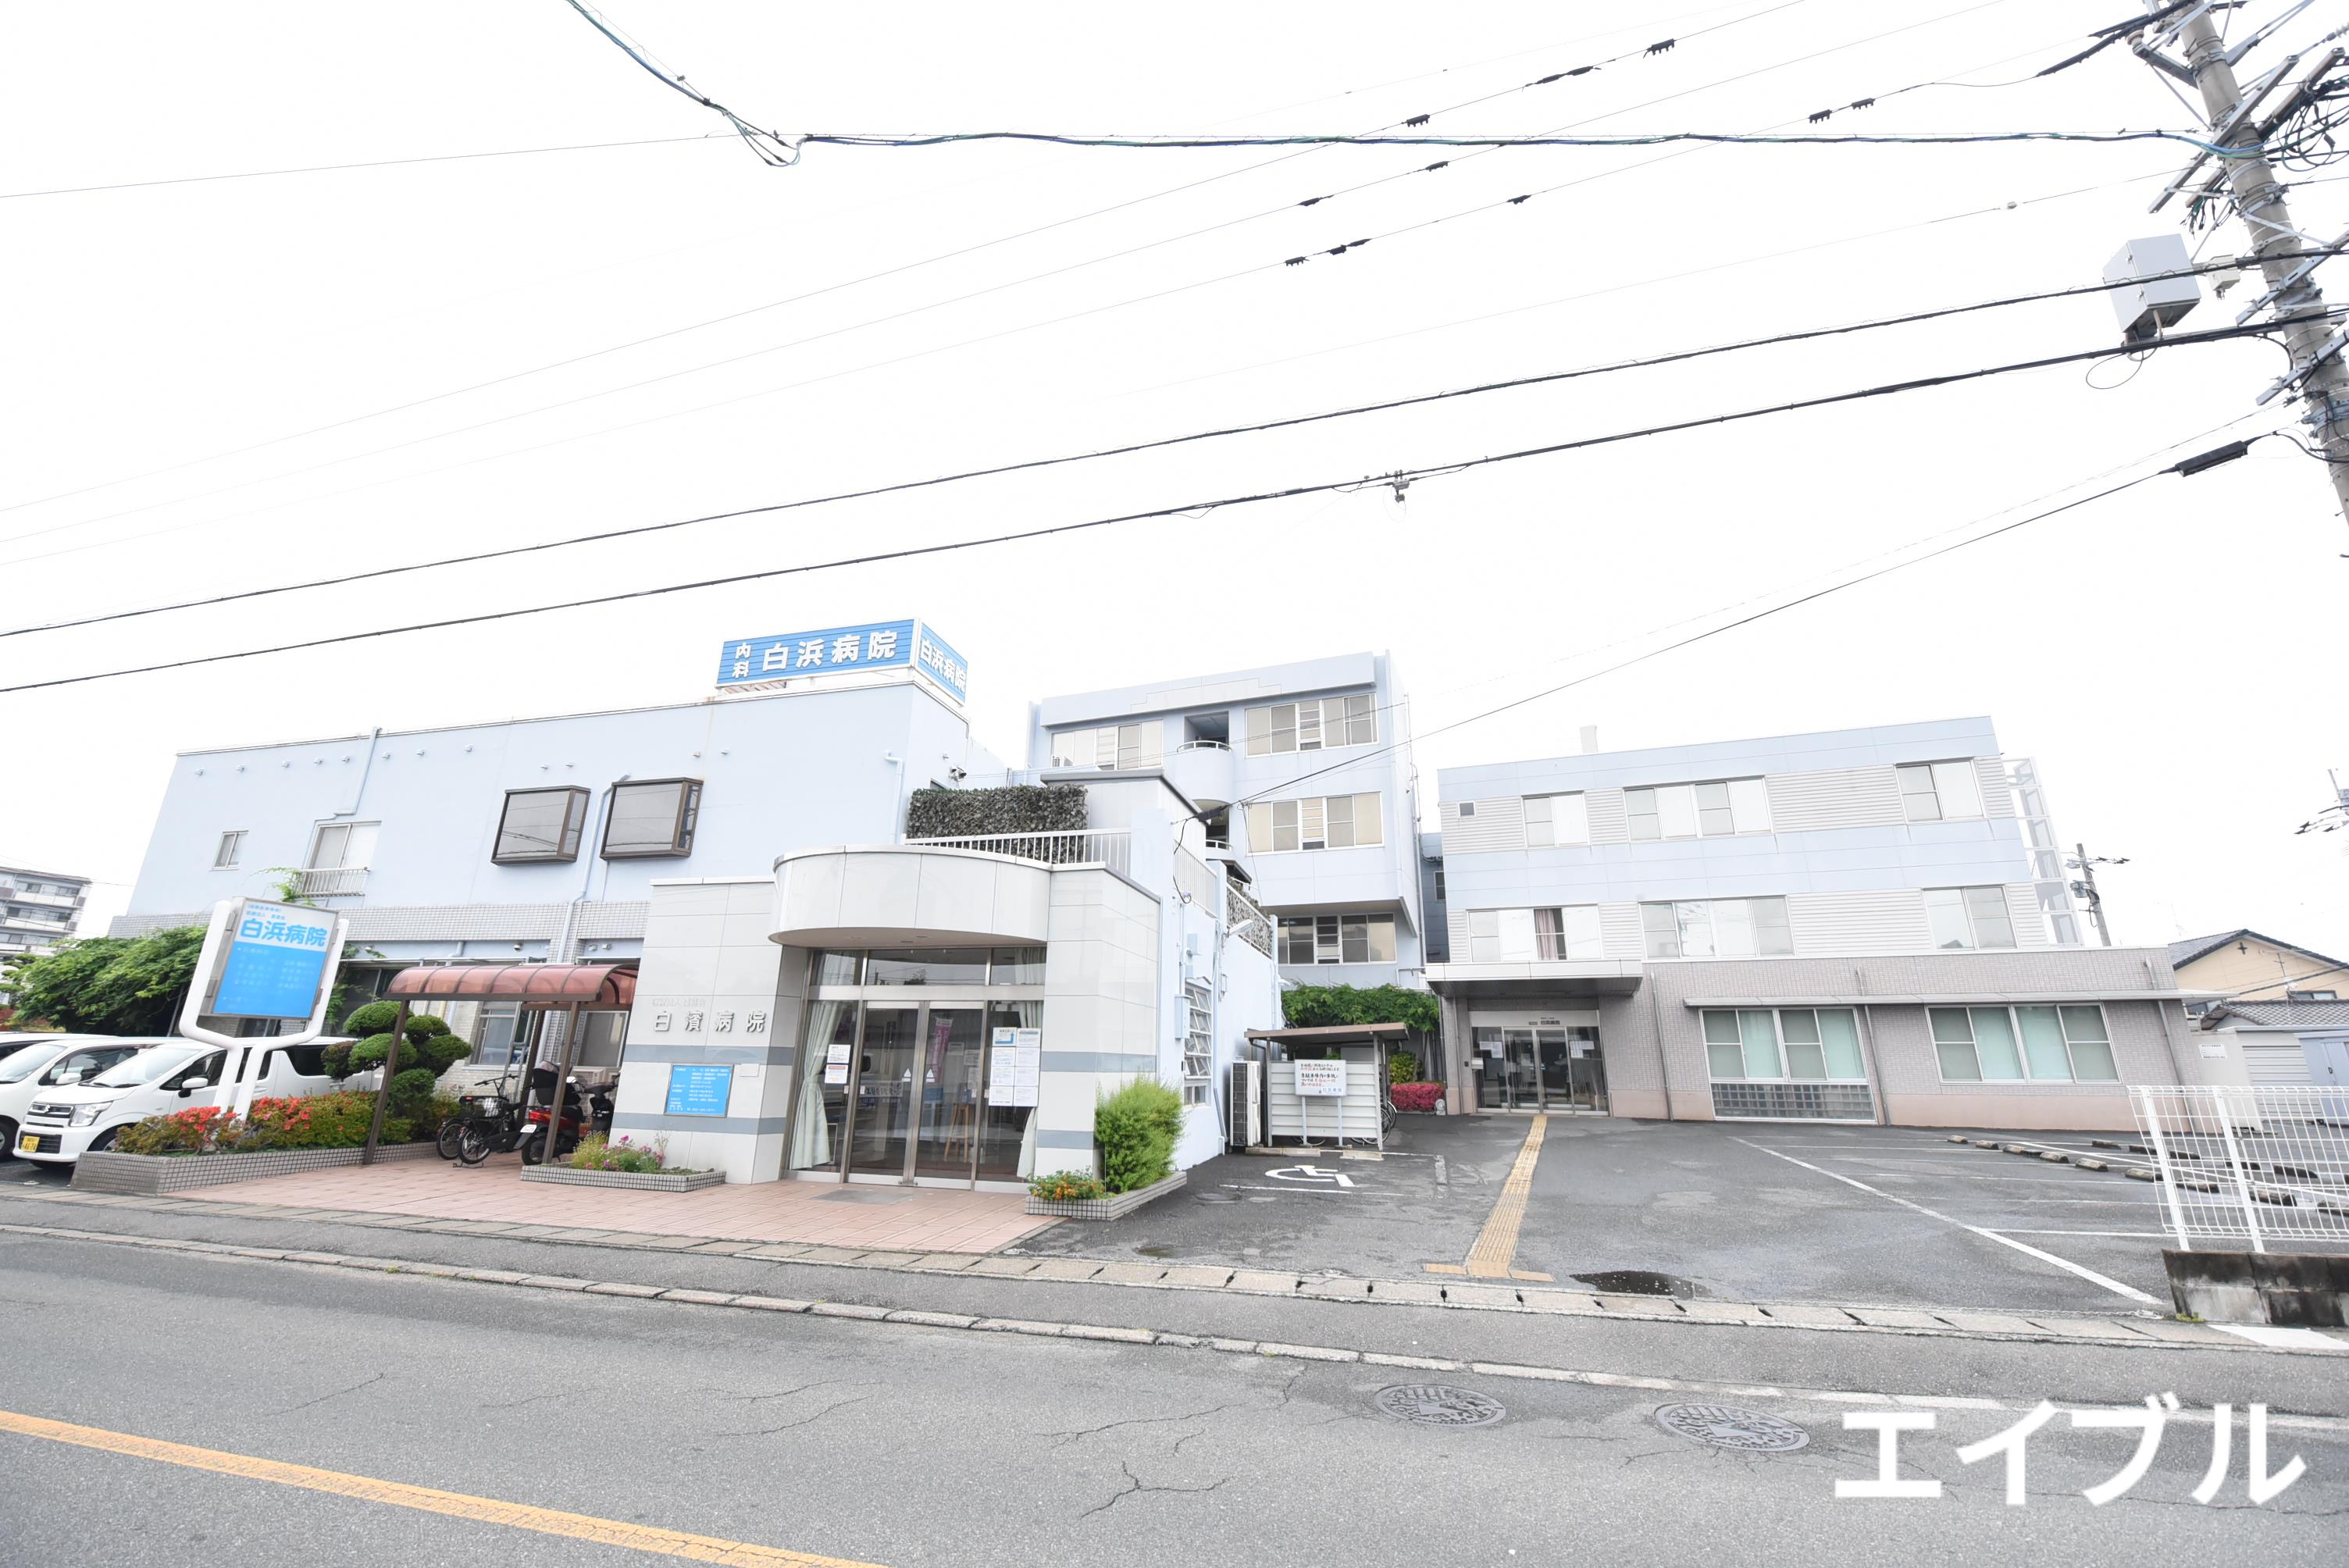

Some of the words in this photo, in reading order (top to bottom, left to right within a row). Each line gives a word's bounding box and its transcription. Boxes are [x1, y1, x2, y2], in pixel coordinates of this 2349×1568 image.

[732, 642, 751, 679] 内科
[762, 630, 897, 672] 白浜病院
[919, 639, 966, 693] 白浜病院
[240, 918, 328, 947] 白浜病院
